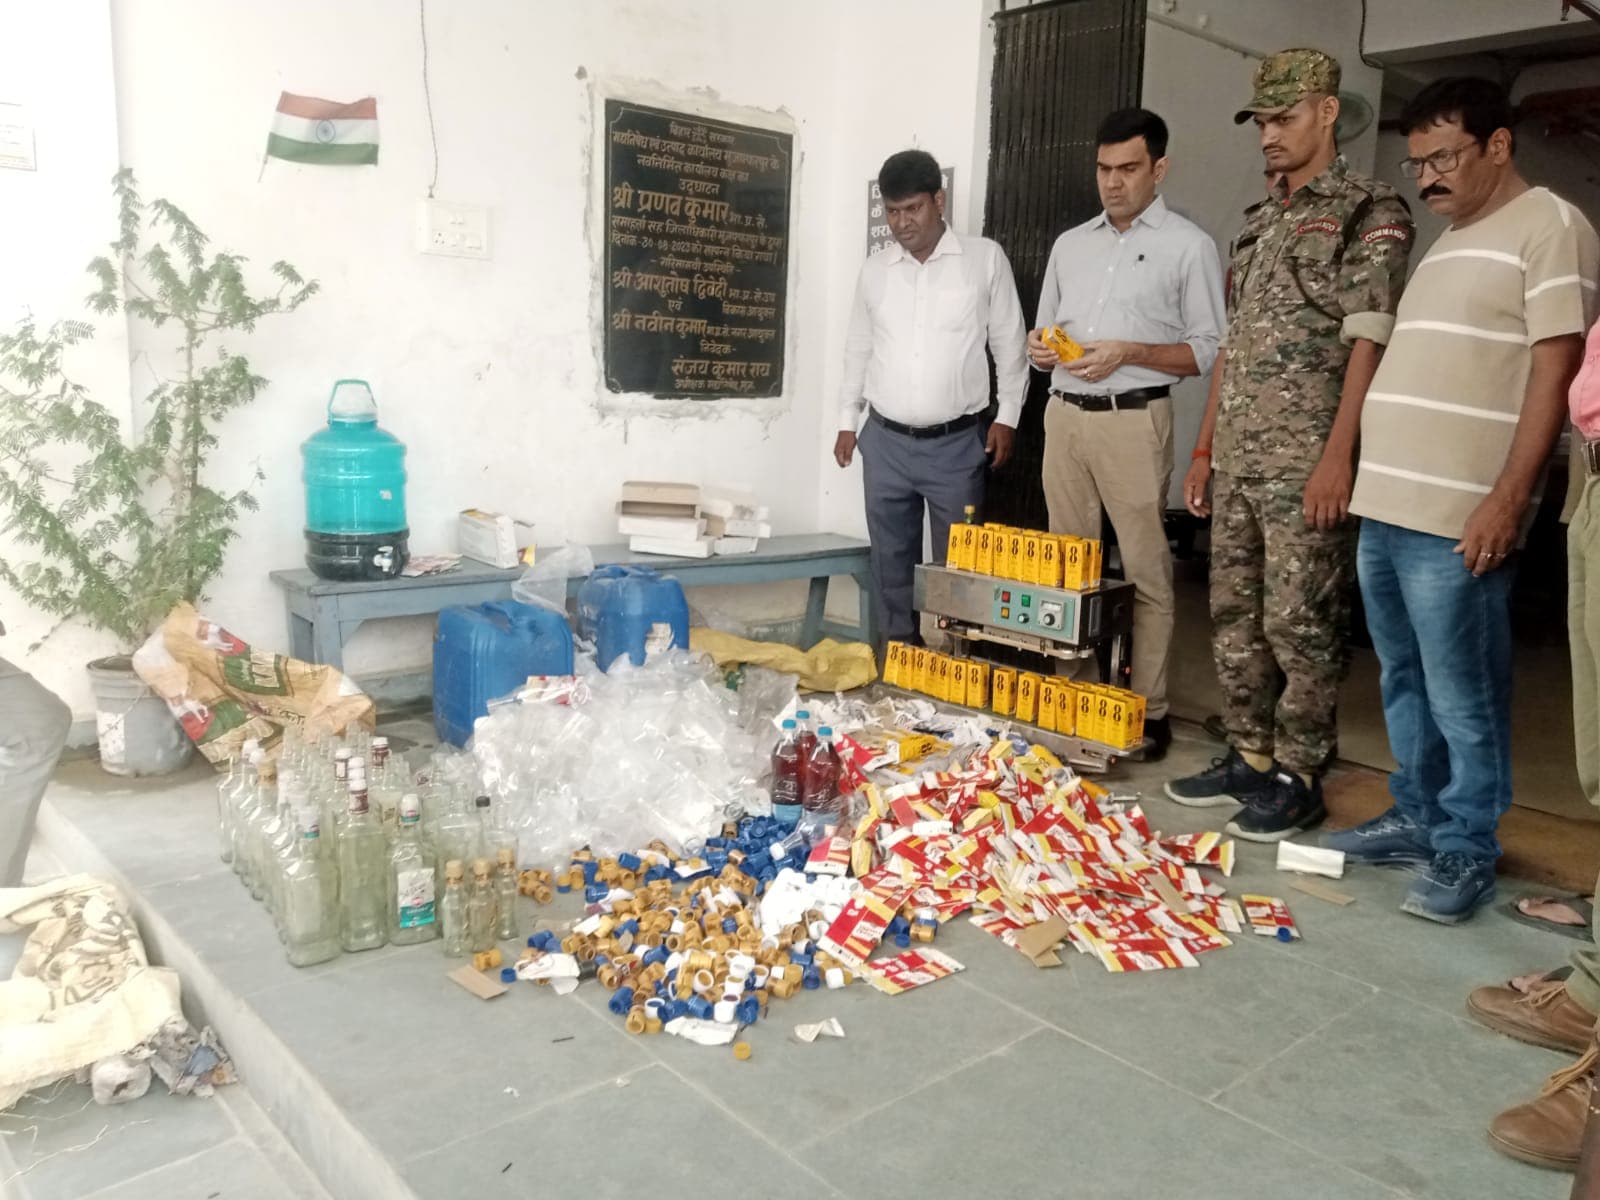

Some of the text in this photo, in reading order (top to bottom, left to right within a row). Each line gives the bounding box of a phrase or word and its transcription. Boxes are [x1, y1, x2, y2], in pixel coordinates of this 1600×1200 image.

[687, 144, 722, 160] कार्यालय
[683, 161, 719, 178] कार्यालय
[613, 181, 634, 209] श्री
[637, 190, 683, 217] प्रणव
[647, 220, 664, 233] सह
[1365, 228, 1406, 242] COMMANDO
[613, 266, 633, 288] श्री
[635, 271, 690, 298] आशुतोष
[668, 297, 683, 311] एवं
[613, 308, 632, 330] श्री
[634, 310, 675, 333] नवीन
[672, 354, 771, 379] संजय कुमार राय
[951, 535, 958, 549] 8
[965, 529, 972, 546] 8
[981, 532, 989, 550] 8
[996, 536, 1003, 554] 8
[1011, 537, 1019, 555] 8
[1027, 540, 1035, 558] 8
[1044, 543, 1053, 561] 8
[1069, 545, 1078, 564] 8
[890, 645, 898, 661] 8
[900, 650, 907, 667] 8
[917, 652, 924, 669] 8
[929, 656, 937, 673] 8
[940, 660, 947, 677] 8
[954, 664, 962, 681] 8
[971, 667, 979, 684] 8
[997, 673, 1004, 691] 8
[1022, 679, 1030, 697] 8
[1044, 686, 1052, 704] 8
[1059, 692, 1066, 710] 8
[1081, 695, 1089, 713] 8
[1098, 699, 1107, 717] 8
[1113, 704, 1122, 721] 8
